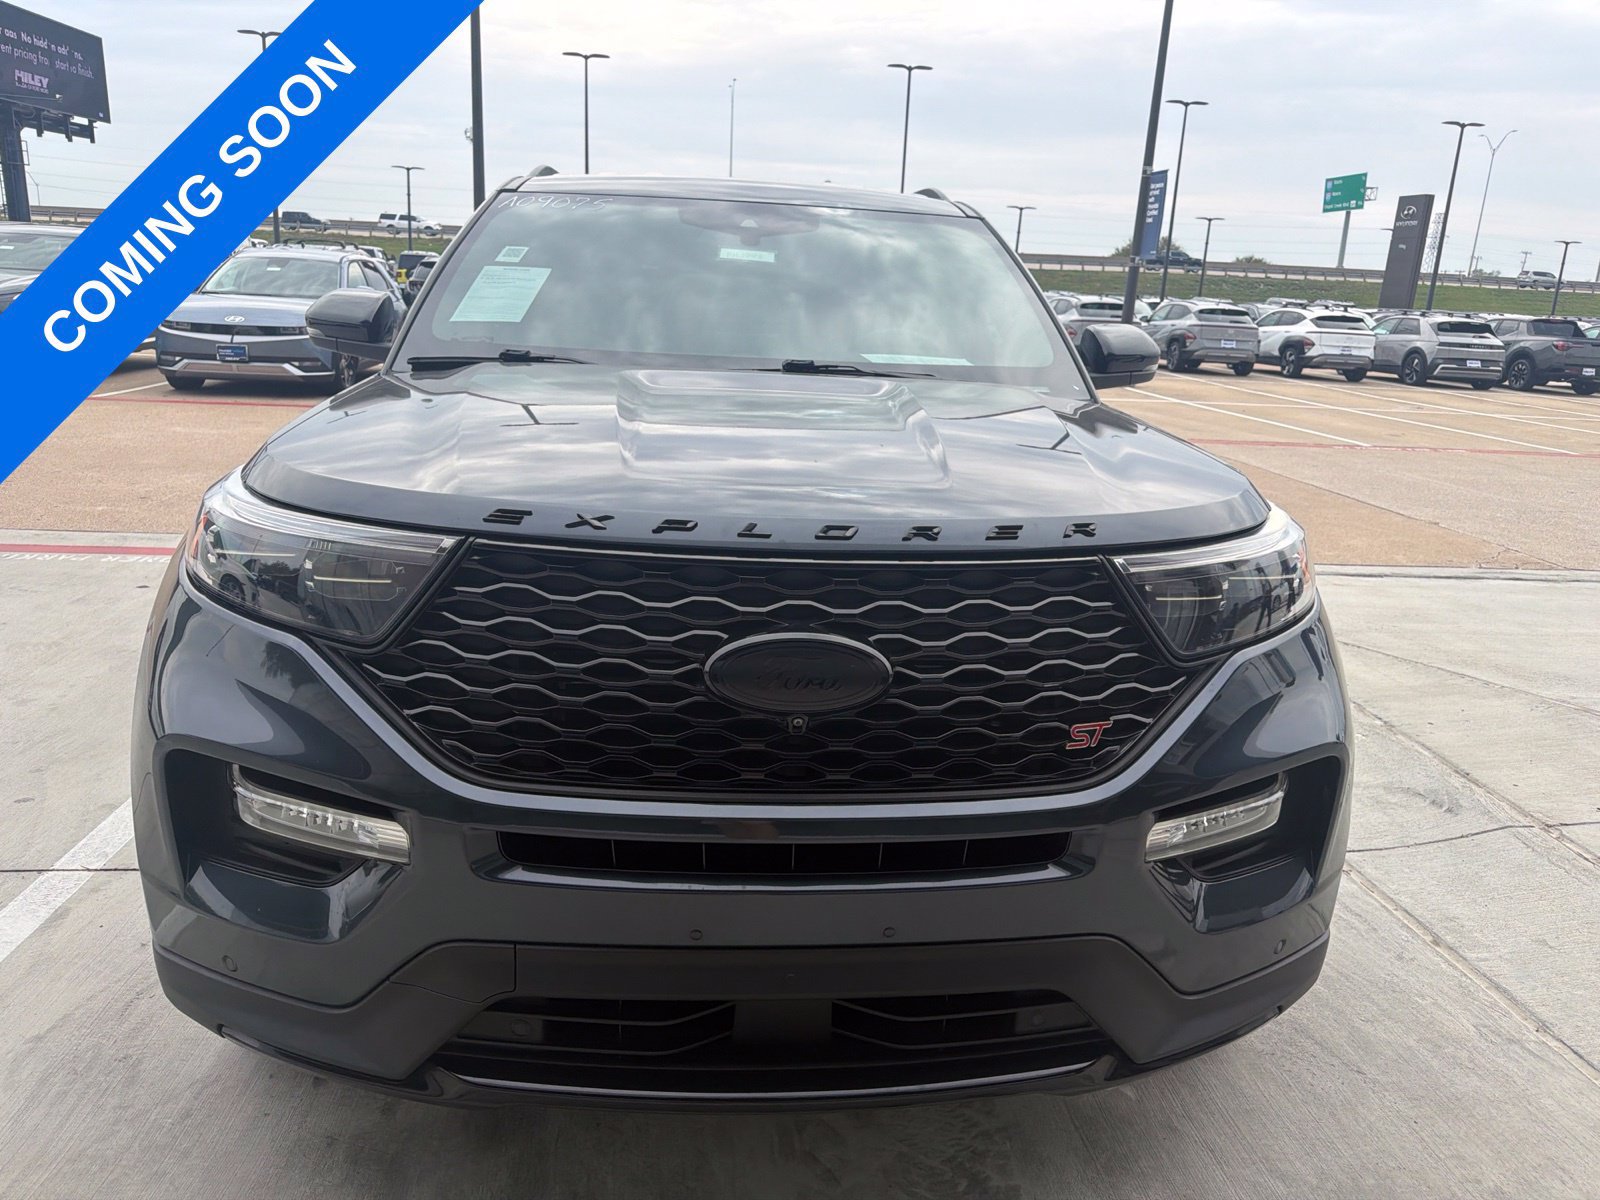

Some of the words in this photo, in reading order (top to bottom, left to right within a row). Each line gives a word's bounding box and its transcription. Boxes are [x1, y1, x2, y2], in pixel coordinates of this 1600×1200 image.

[21, 32, 32, 44] No
[13, 47, 37, 65] pricing
[55, 60, 69, 71] start
[14, 69, 49, 88] HILEY
[482, 508, 1098, 541] EXPLORER
[1065, 720, 1114, 750] ST
